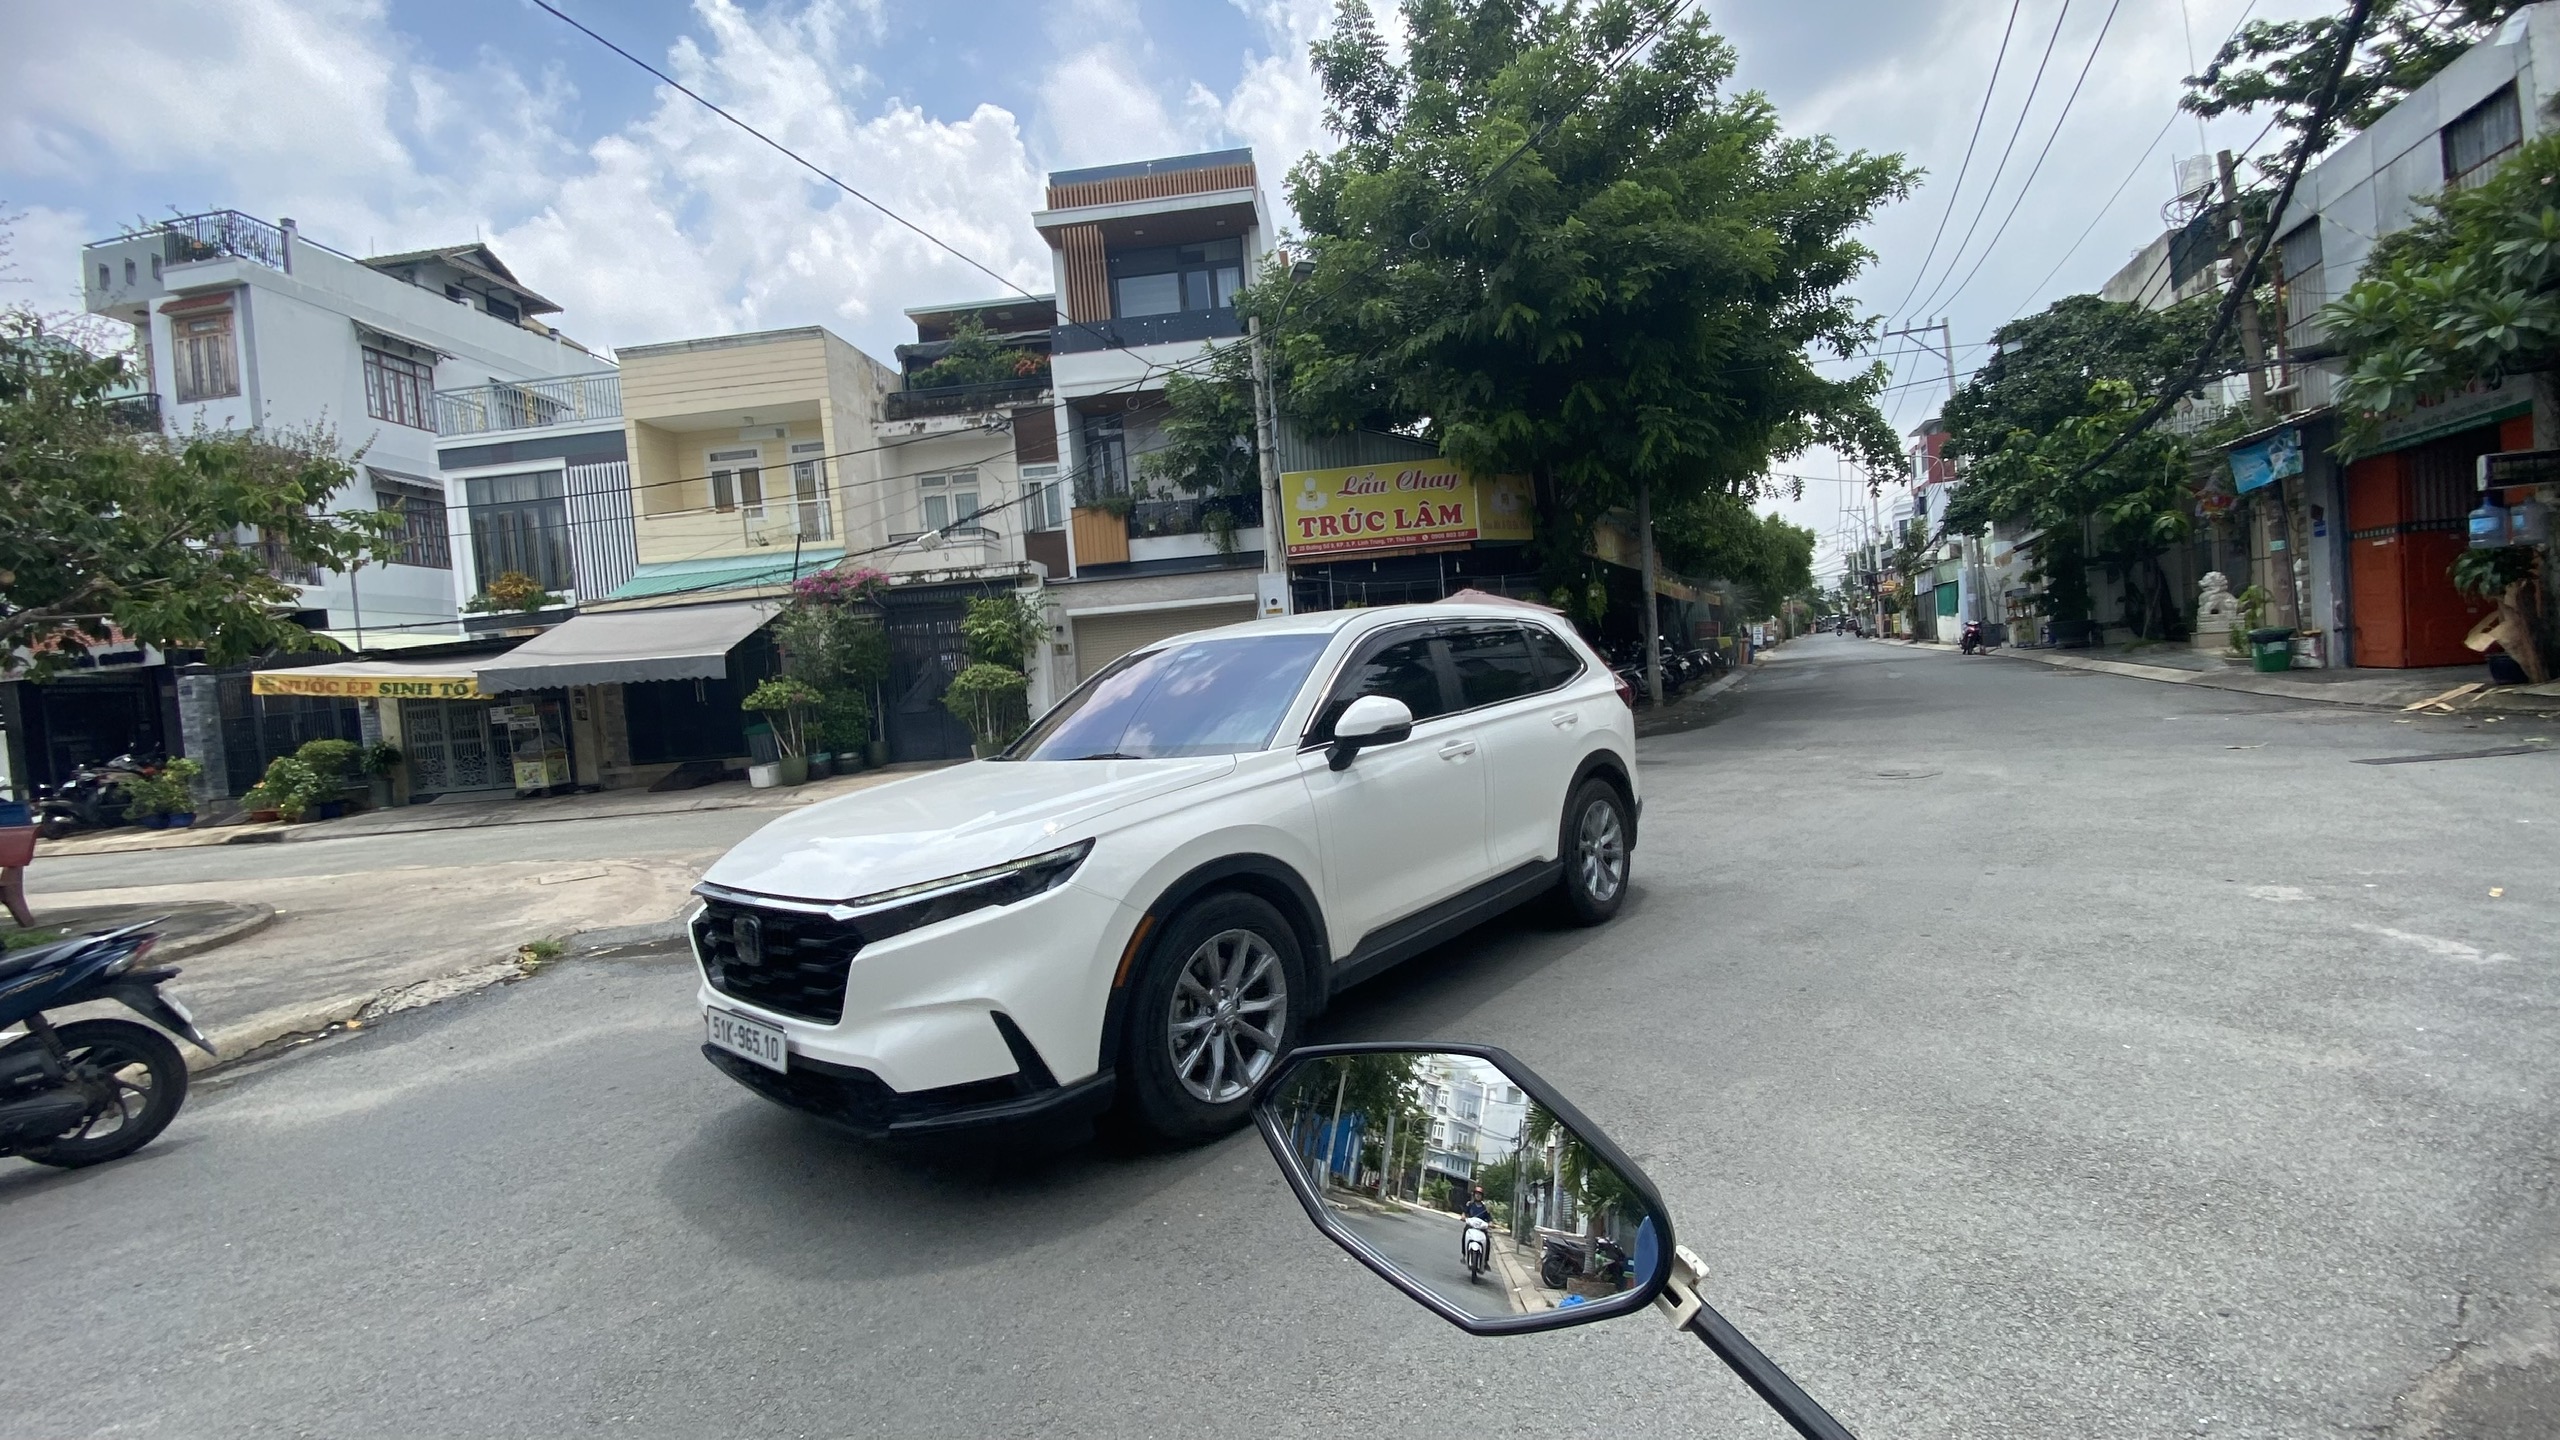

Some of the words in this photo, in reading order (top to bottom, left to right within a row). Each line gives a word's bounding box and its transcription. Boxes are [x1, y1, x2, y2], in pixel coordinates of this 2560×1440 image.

[1337, 472, 1387, 495] Lẩu
[1396, 470, 1458, 491] Chay
[1297, 507, 1385, 538] TRÚC
[1393, 501, 1463, 529] LÂM
[278, 677, 339, 693] NƯỚC
[346, 678, 372, 694] ÉP
[379, 682, 432, 695] SINH
[439, 678, 469, 695] TỐ
[713, 1016, 779, 1063] 51K-965.10
